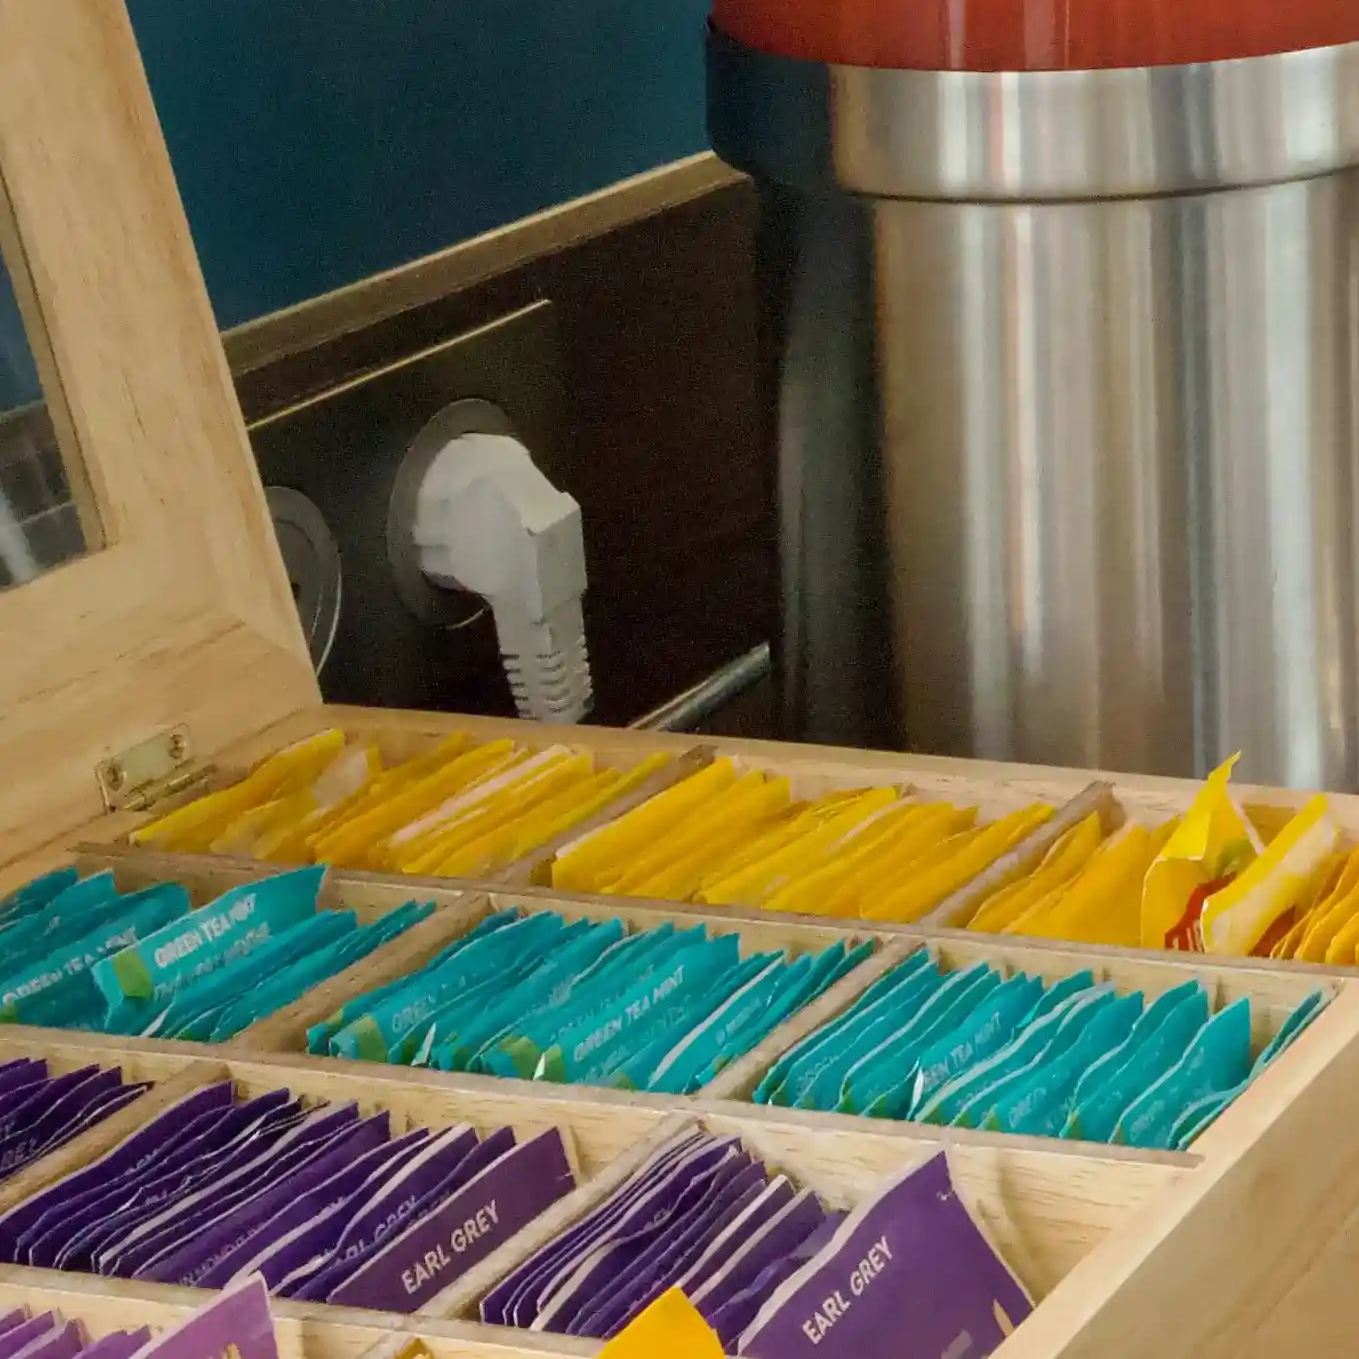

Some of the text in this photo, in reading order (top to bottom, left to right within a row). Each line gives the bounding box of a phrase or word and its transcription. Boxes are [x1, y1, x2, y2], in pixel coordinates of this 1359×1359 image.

[401, 1242, 451, 1295] EARL
[450, 1198, 500, 1254] GREY
[802, 1234, 893, 1345] EARL GREY
